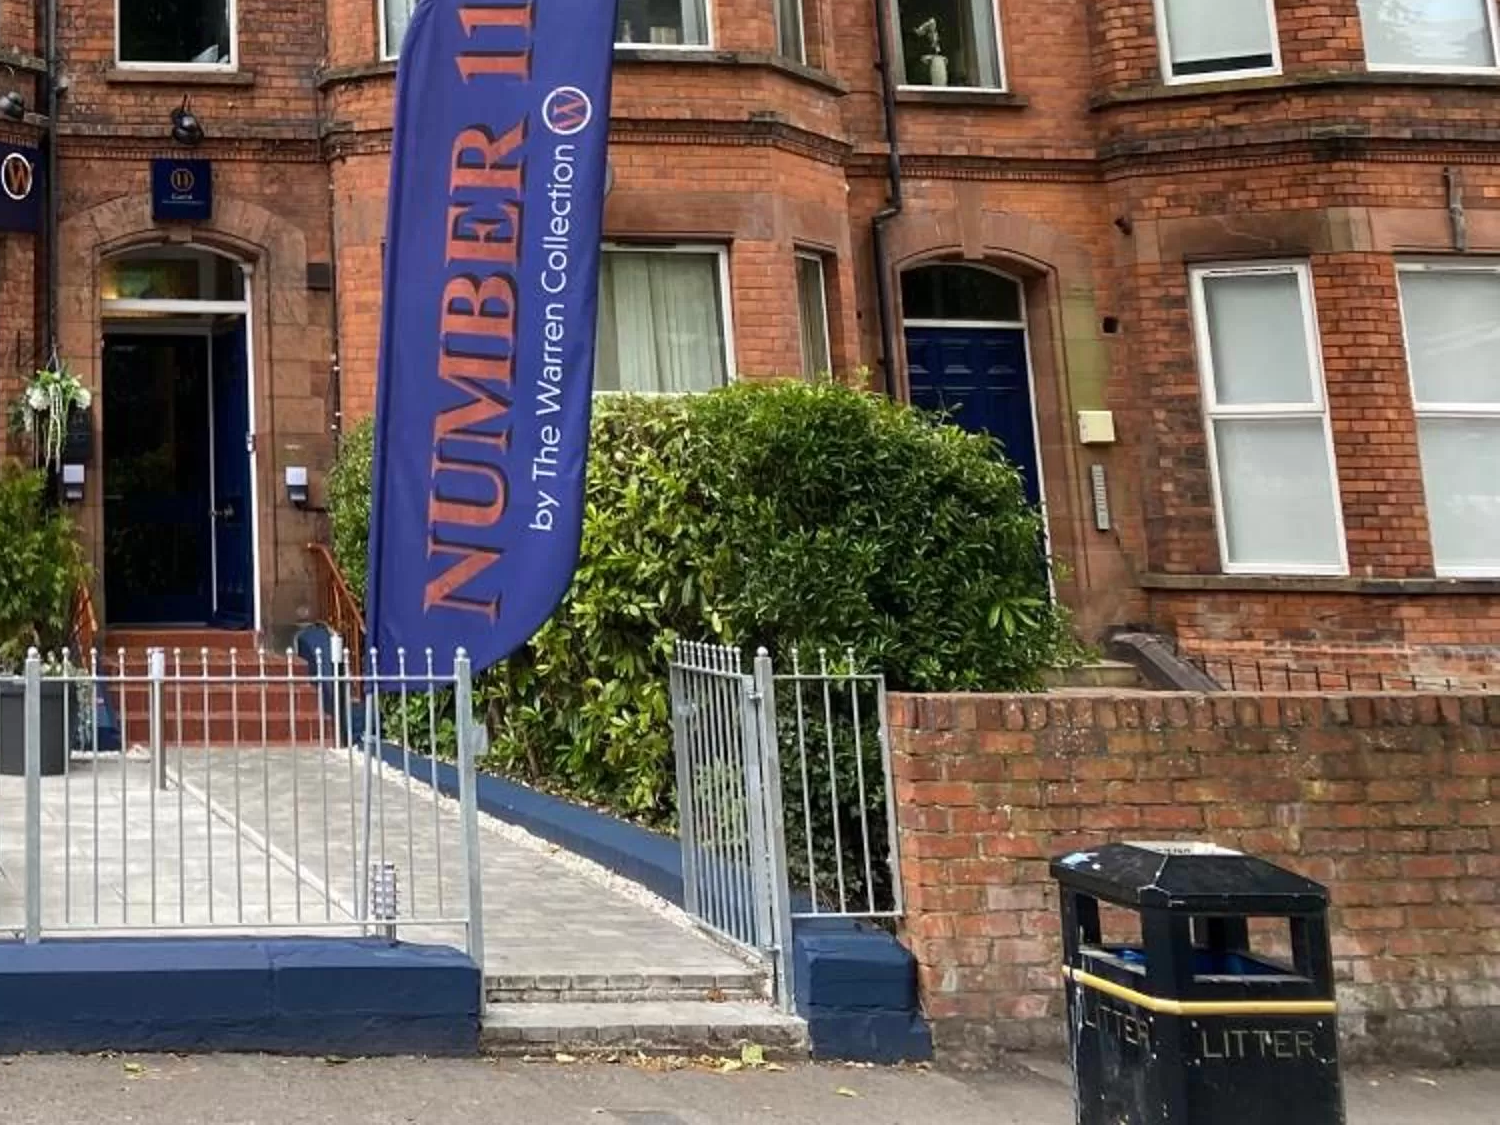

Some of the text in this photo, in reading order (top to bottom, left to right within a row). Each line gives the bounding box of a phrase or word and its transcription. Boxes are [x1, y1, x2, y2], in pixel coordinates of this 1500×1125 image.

[423, 119, 527, 625] NUMBER
[528, 143, 576, 531] by The Warren Collection
[1201, 1029, 1318, 1059] LITTER
